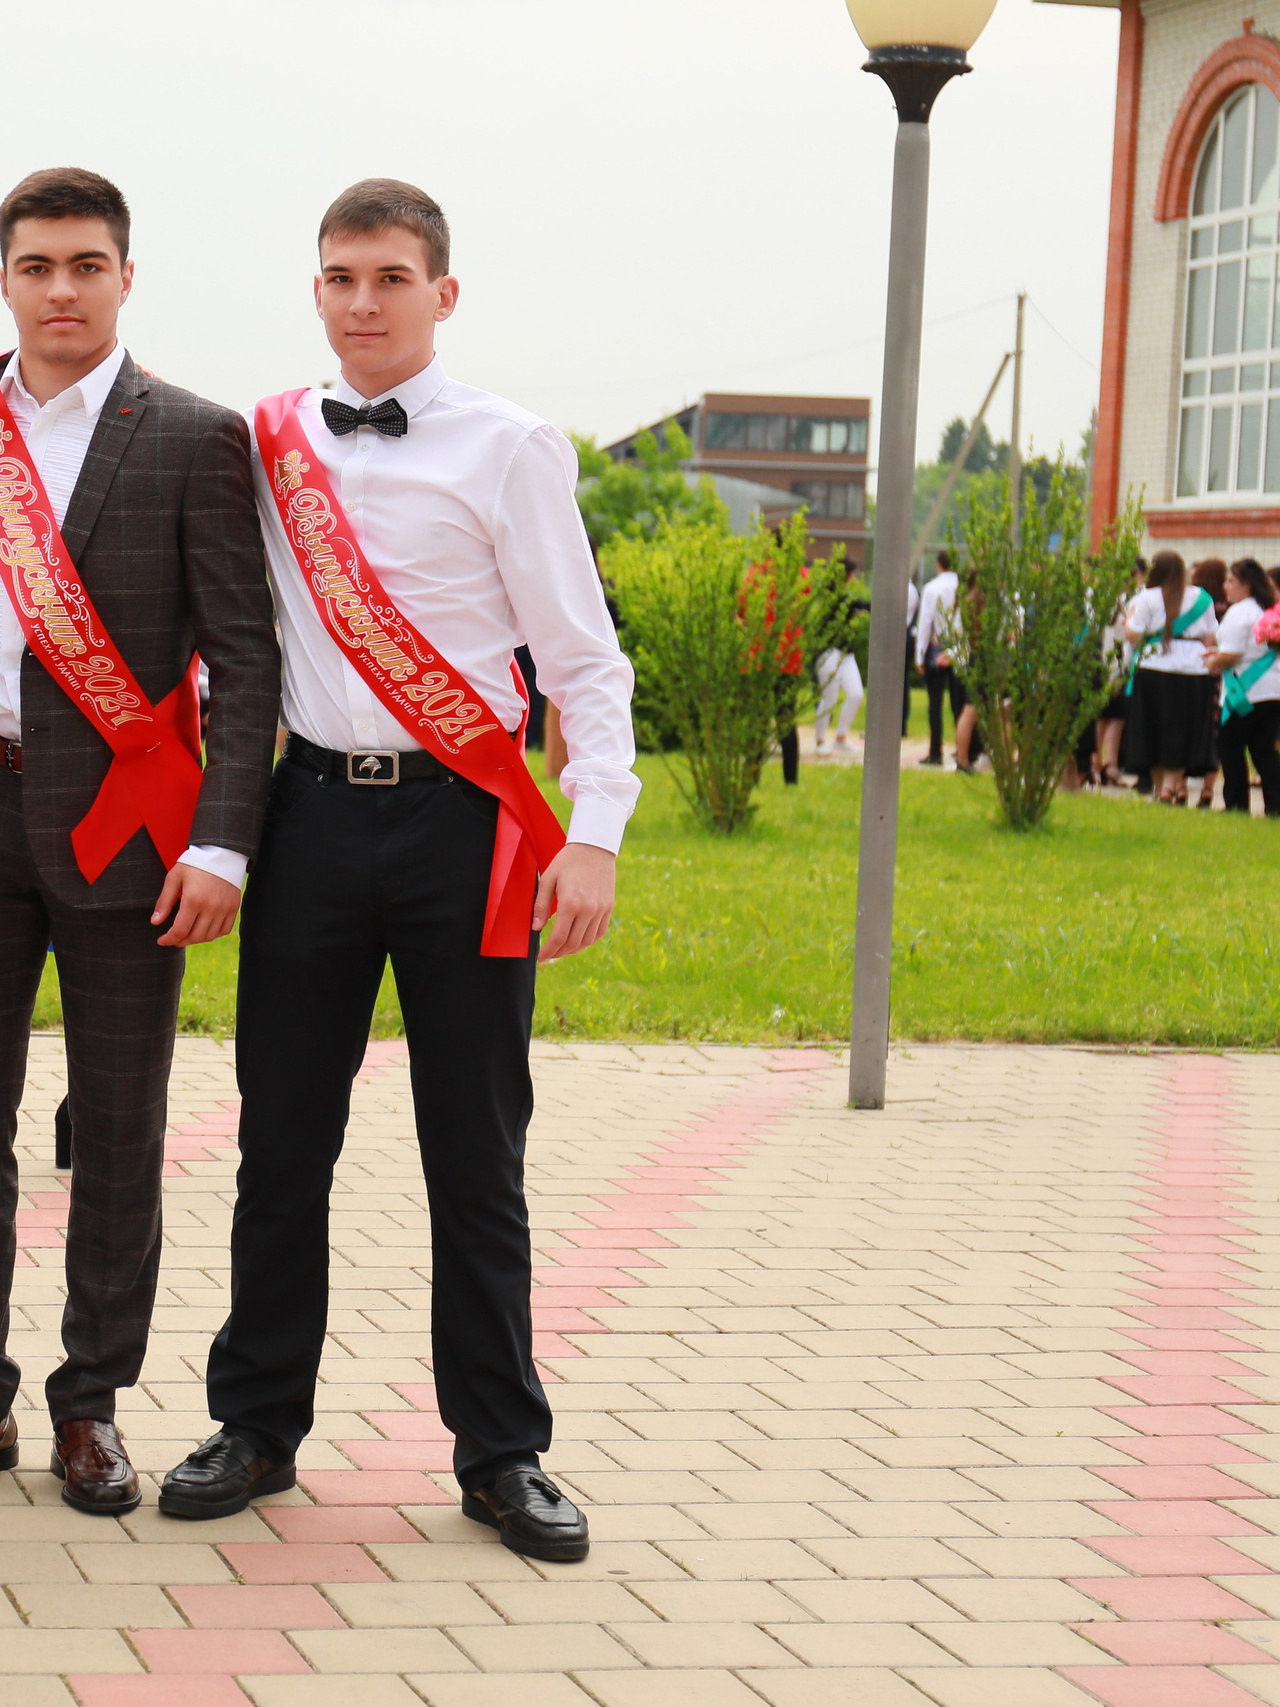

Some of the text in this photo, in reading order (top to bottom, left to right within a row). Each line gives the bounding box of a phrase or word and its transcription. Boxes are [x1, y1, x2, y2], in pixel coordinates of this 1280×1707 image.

[288, 487, 499, 748] Выпускник 2021
[30, 622, 55, 655] УСПЕХА
[54, 661, 82, 691] УДАЧИ!
[67, 655, 154, 727] 2021
[357, 652, 386, 682] УСПЕХА
[388, 690, 419, 718] УДАЧИ!
